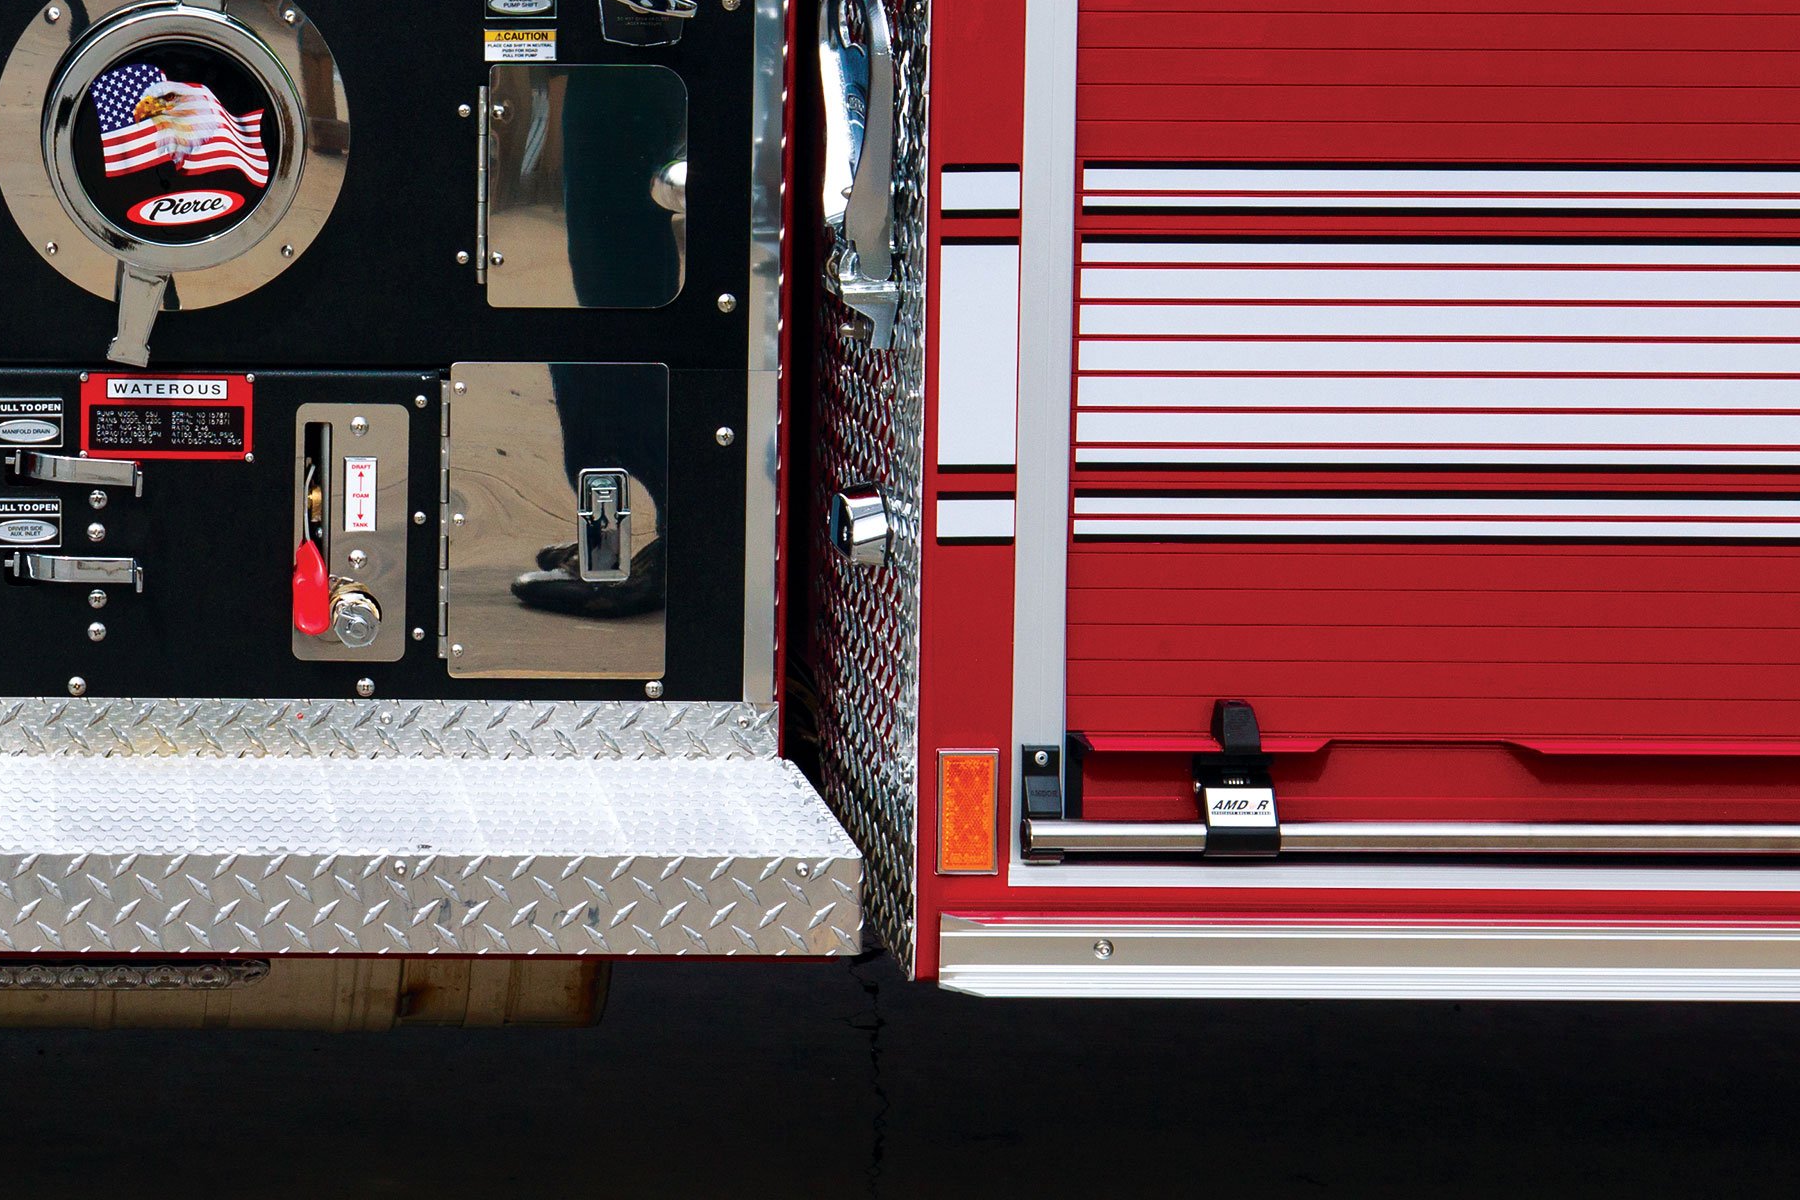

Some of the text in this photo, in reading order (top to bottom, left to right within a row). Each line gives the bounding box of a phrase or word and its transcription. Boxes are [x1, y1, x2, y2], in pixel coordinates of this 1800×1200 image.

[503, 32, 549, 41] CAUTION
[149, 195, 225, 220] Pierce
[114, 384, 222, 395] WATEROUS
[20, 404, 33, 412] TO
[35, 403, 61, 411] OPEN
[18, 503, 31, 511] TO
[33, 503, 59, 511] OPEN
